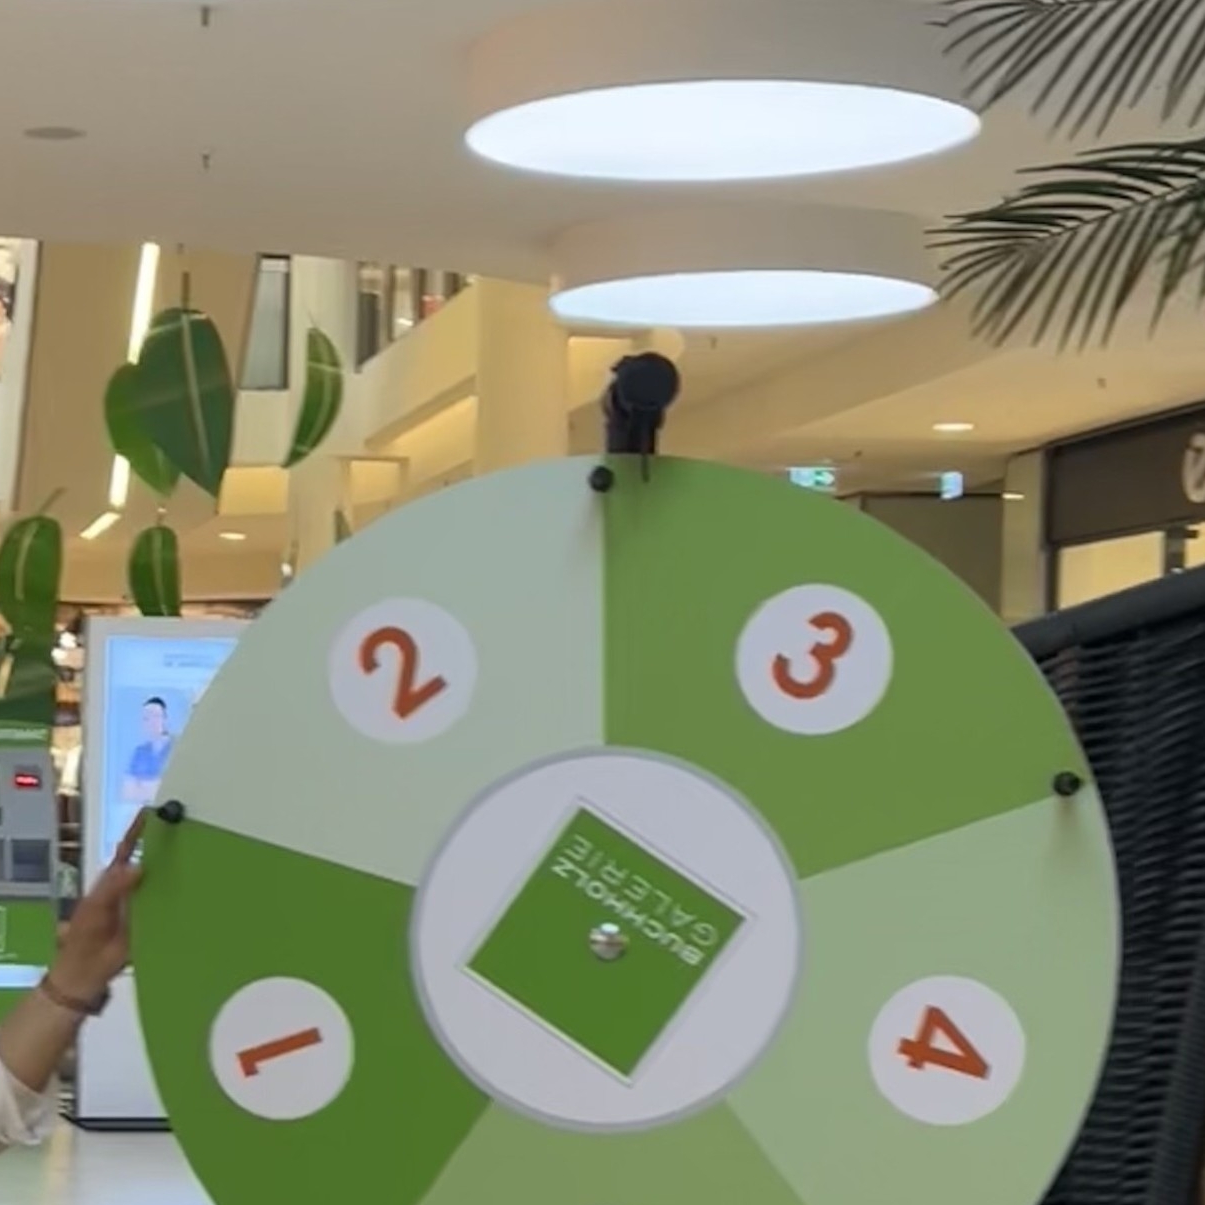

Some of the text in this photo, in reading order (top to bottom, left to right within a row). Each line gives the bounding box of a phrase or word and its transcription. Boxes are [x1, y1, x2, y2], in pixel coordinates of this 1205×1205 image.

[358, 625, 448, 722] 2
[771, 611, 854, 699] 3
[551, 856, 705, 966] BUCHHOLZ
[564, 833, 718, 946] GALERIE
[235, 1027, 323, 1078] 1
[896, 1005, 991, 1081] 4
